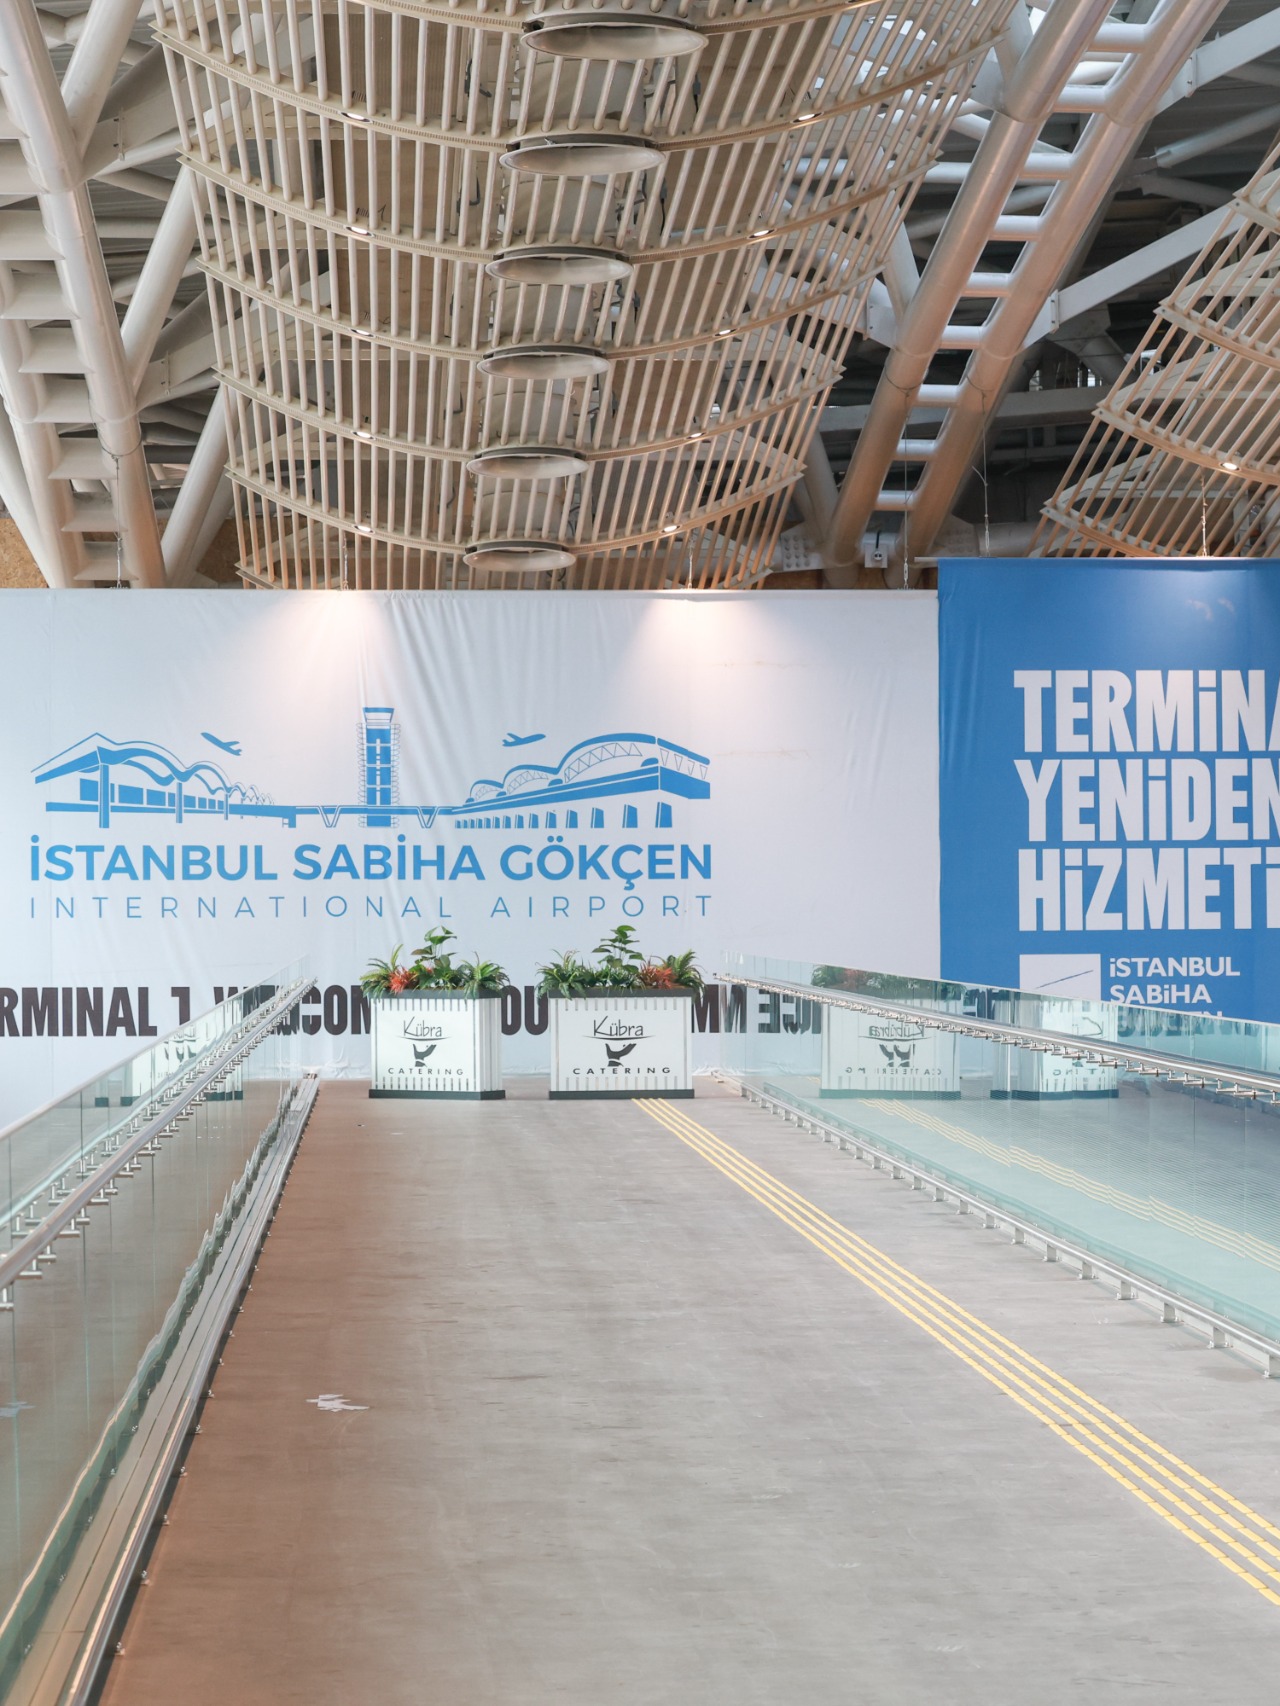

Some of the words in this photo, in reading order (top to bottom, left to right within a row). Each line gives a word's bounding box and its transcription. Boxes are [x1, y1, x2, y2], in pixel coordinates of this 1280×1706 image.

[30, 833, 279, 882] İSTANBUL
[292, 834, 486, 882] SABİHA
[499, 835, 712, 892] GÖKÇEN
[30, 895, 453, 919] INTERNATIONAL
[490, 895, 711, 919] AIRPORT
[403, 1015, 444, 1038] Kübra
[593, 1015, 645, 1038] Kübra
[387, 1067, 465, 1076] CATERING
[572, 1066, 672, 1076] CATERING
